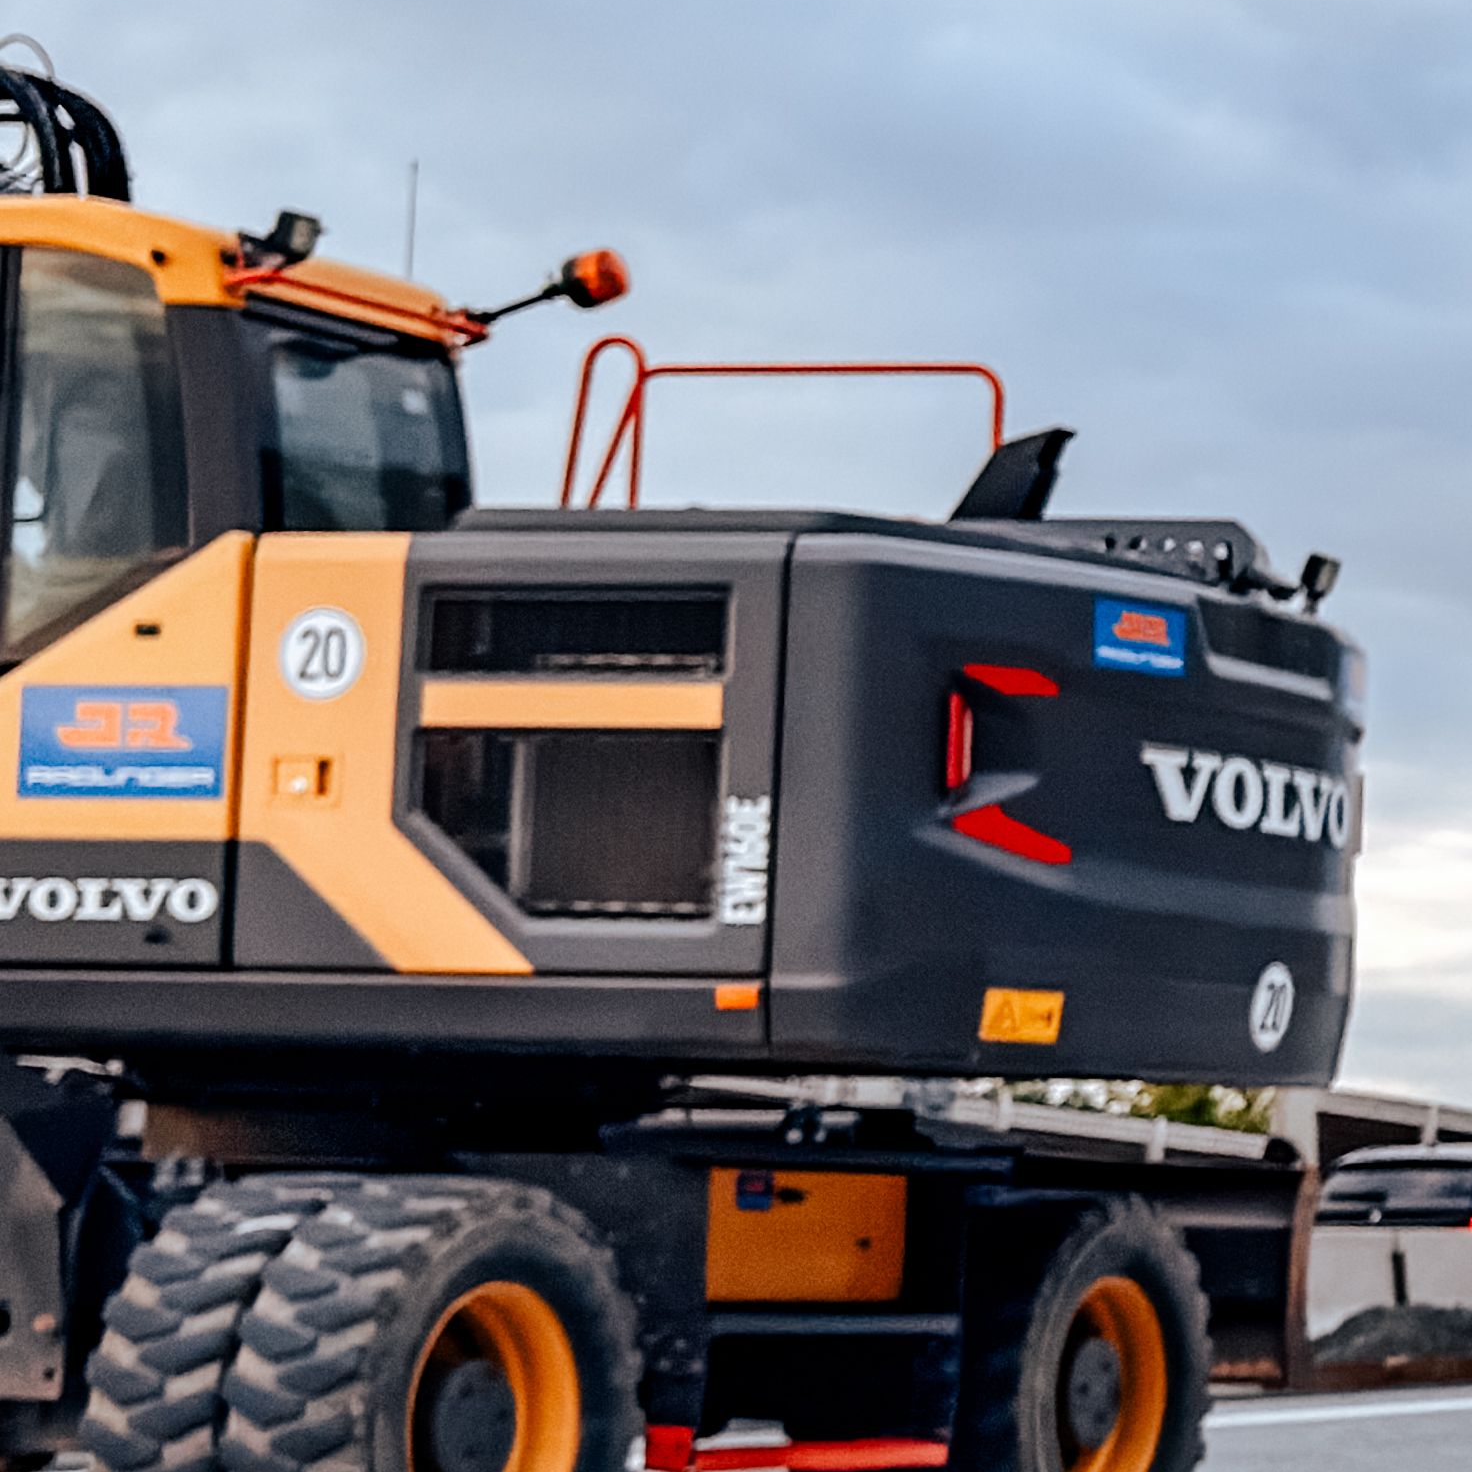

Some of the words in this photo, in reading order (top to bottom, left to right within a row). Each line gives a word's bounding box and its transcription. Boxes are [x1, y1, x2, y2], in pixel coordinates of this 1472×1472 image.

[298, 626, 346, 680] 20
[1140, 742, 1348, 849] VOLVO
[1259, 982, 1288, 1031] 20
